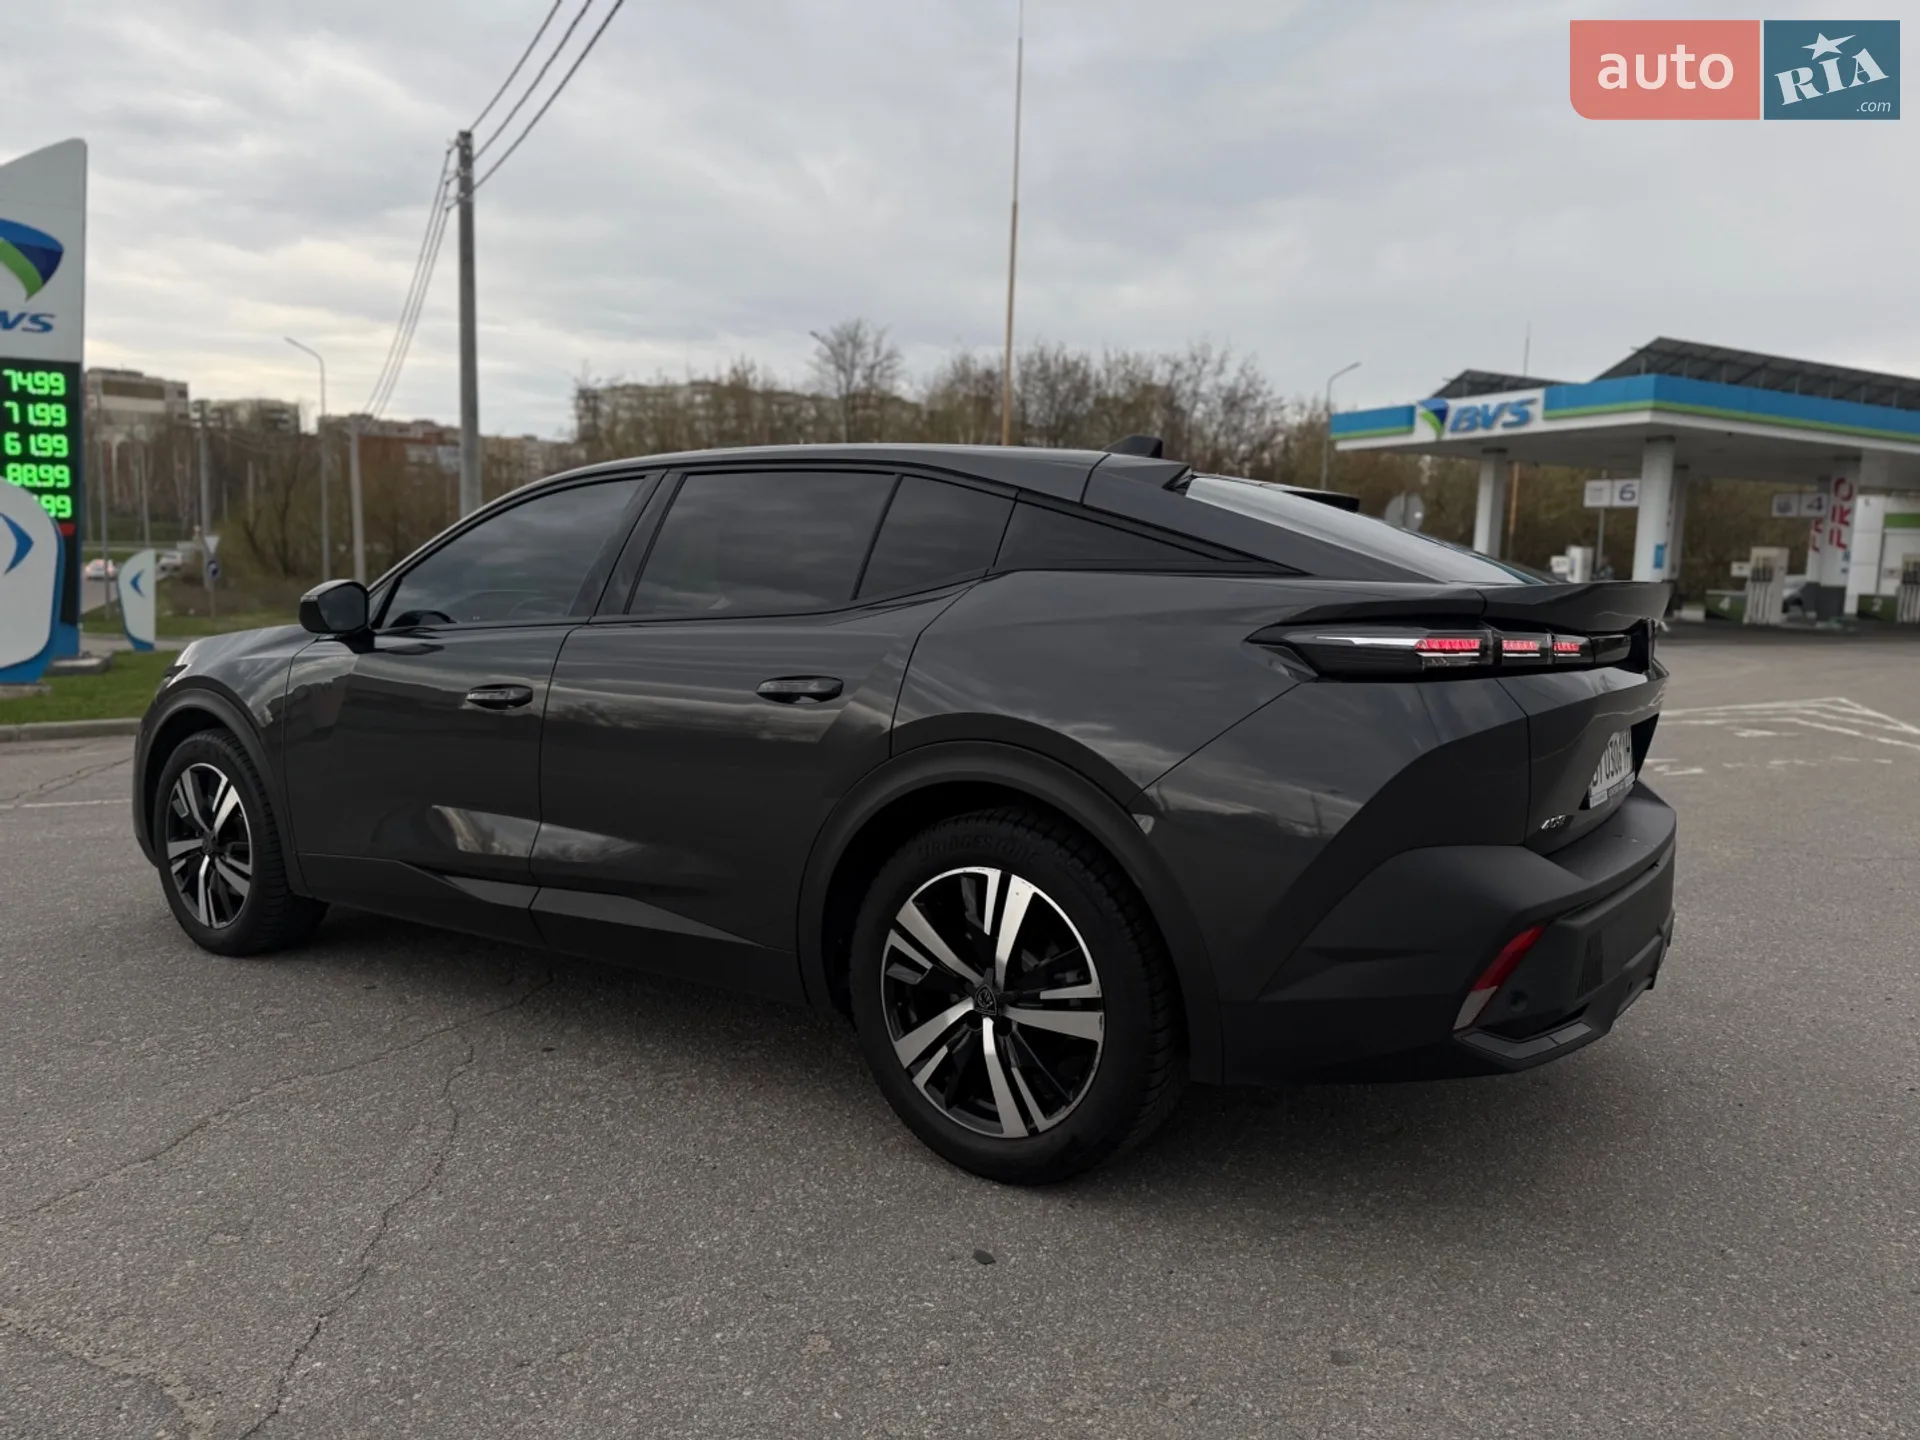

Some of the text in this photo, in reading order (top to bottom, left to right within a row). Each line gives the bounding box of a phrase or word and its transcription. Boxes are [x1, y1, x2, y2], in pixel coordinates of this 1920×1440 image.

[1447, 398, 1538, 432] BVS
[1619, 483, 1636, 502] 6
[1806, 496, 1823, 511] 4
